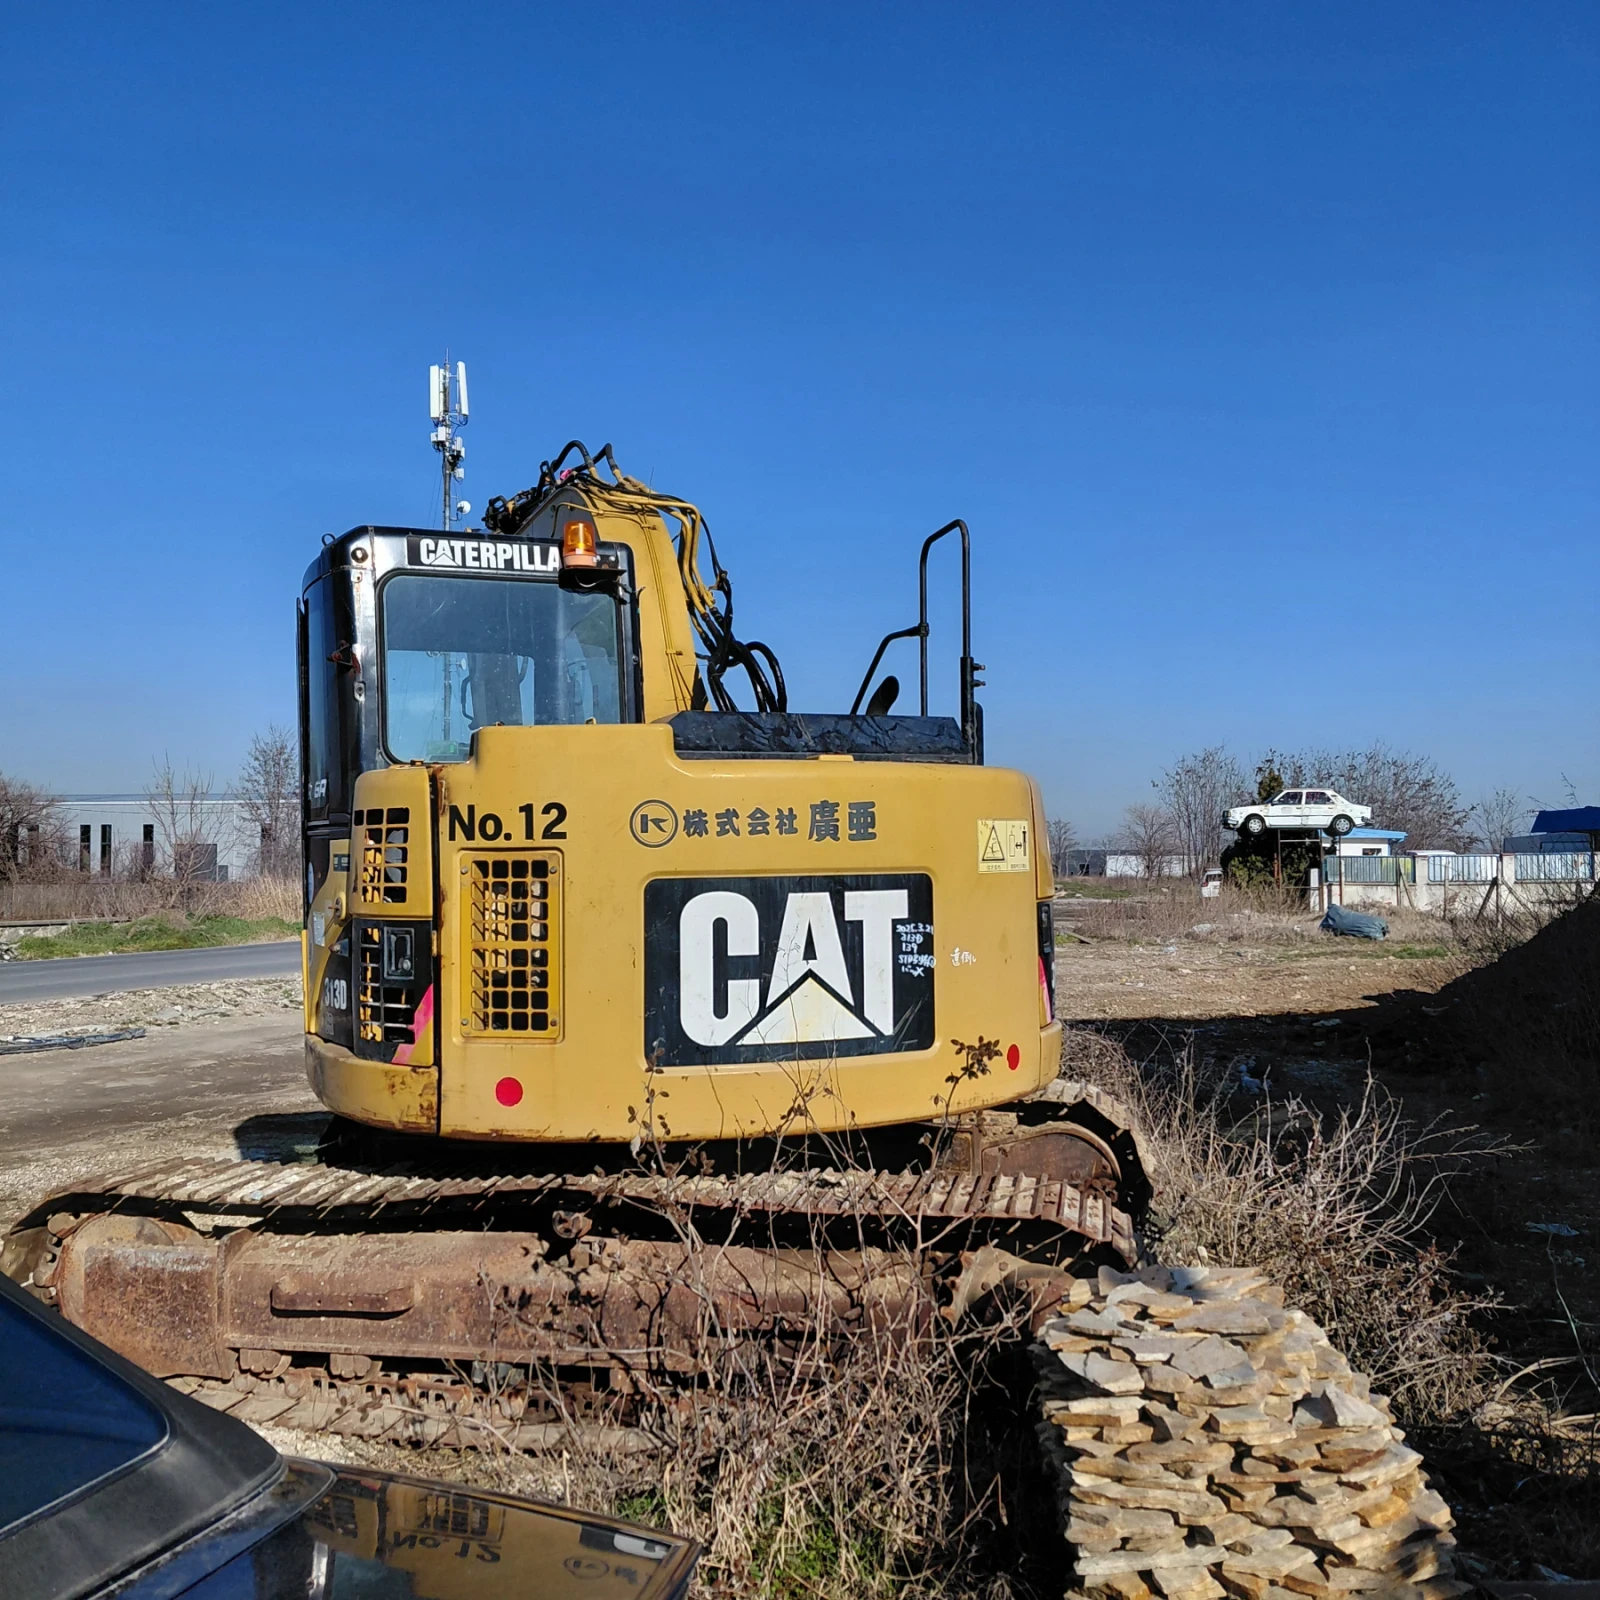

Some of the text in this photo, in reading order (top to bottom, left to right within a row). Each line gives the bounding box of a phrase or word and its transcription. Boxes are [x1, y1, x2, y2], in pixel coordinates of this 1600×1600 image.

[419, 538, 560, 572] CATERPILLA
[448, 802, 568, 842] No.12
[680, 889, 908, 1047] CAT
[324, 977, 347, 1010] 313D
